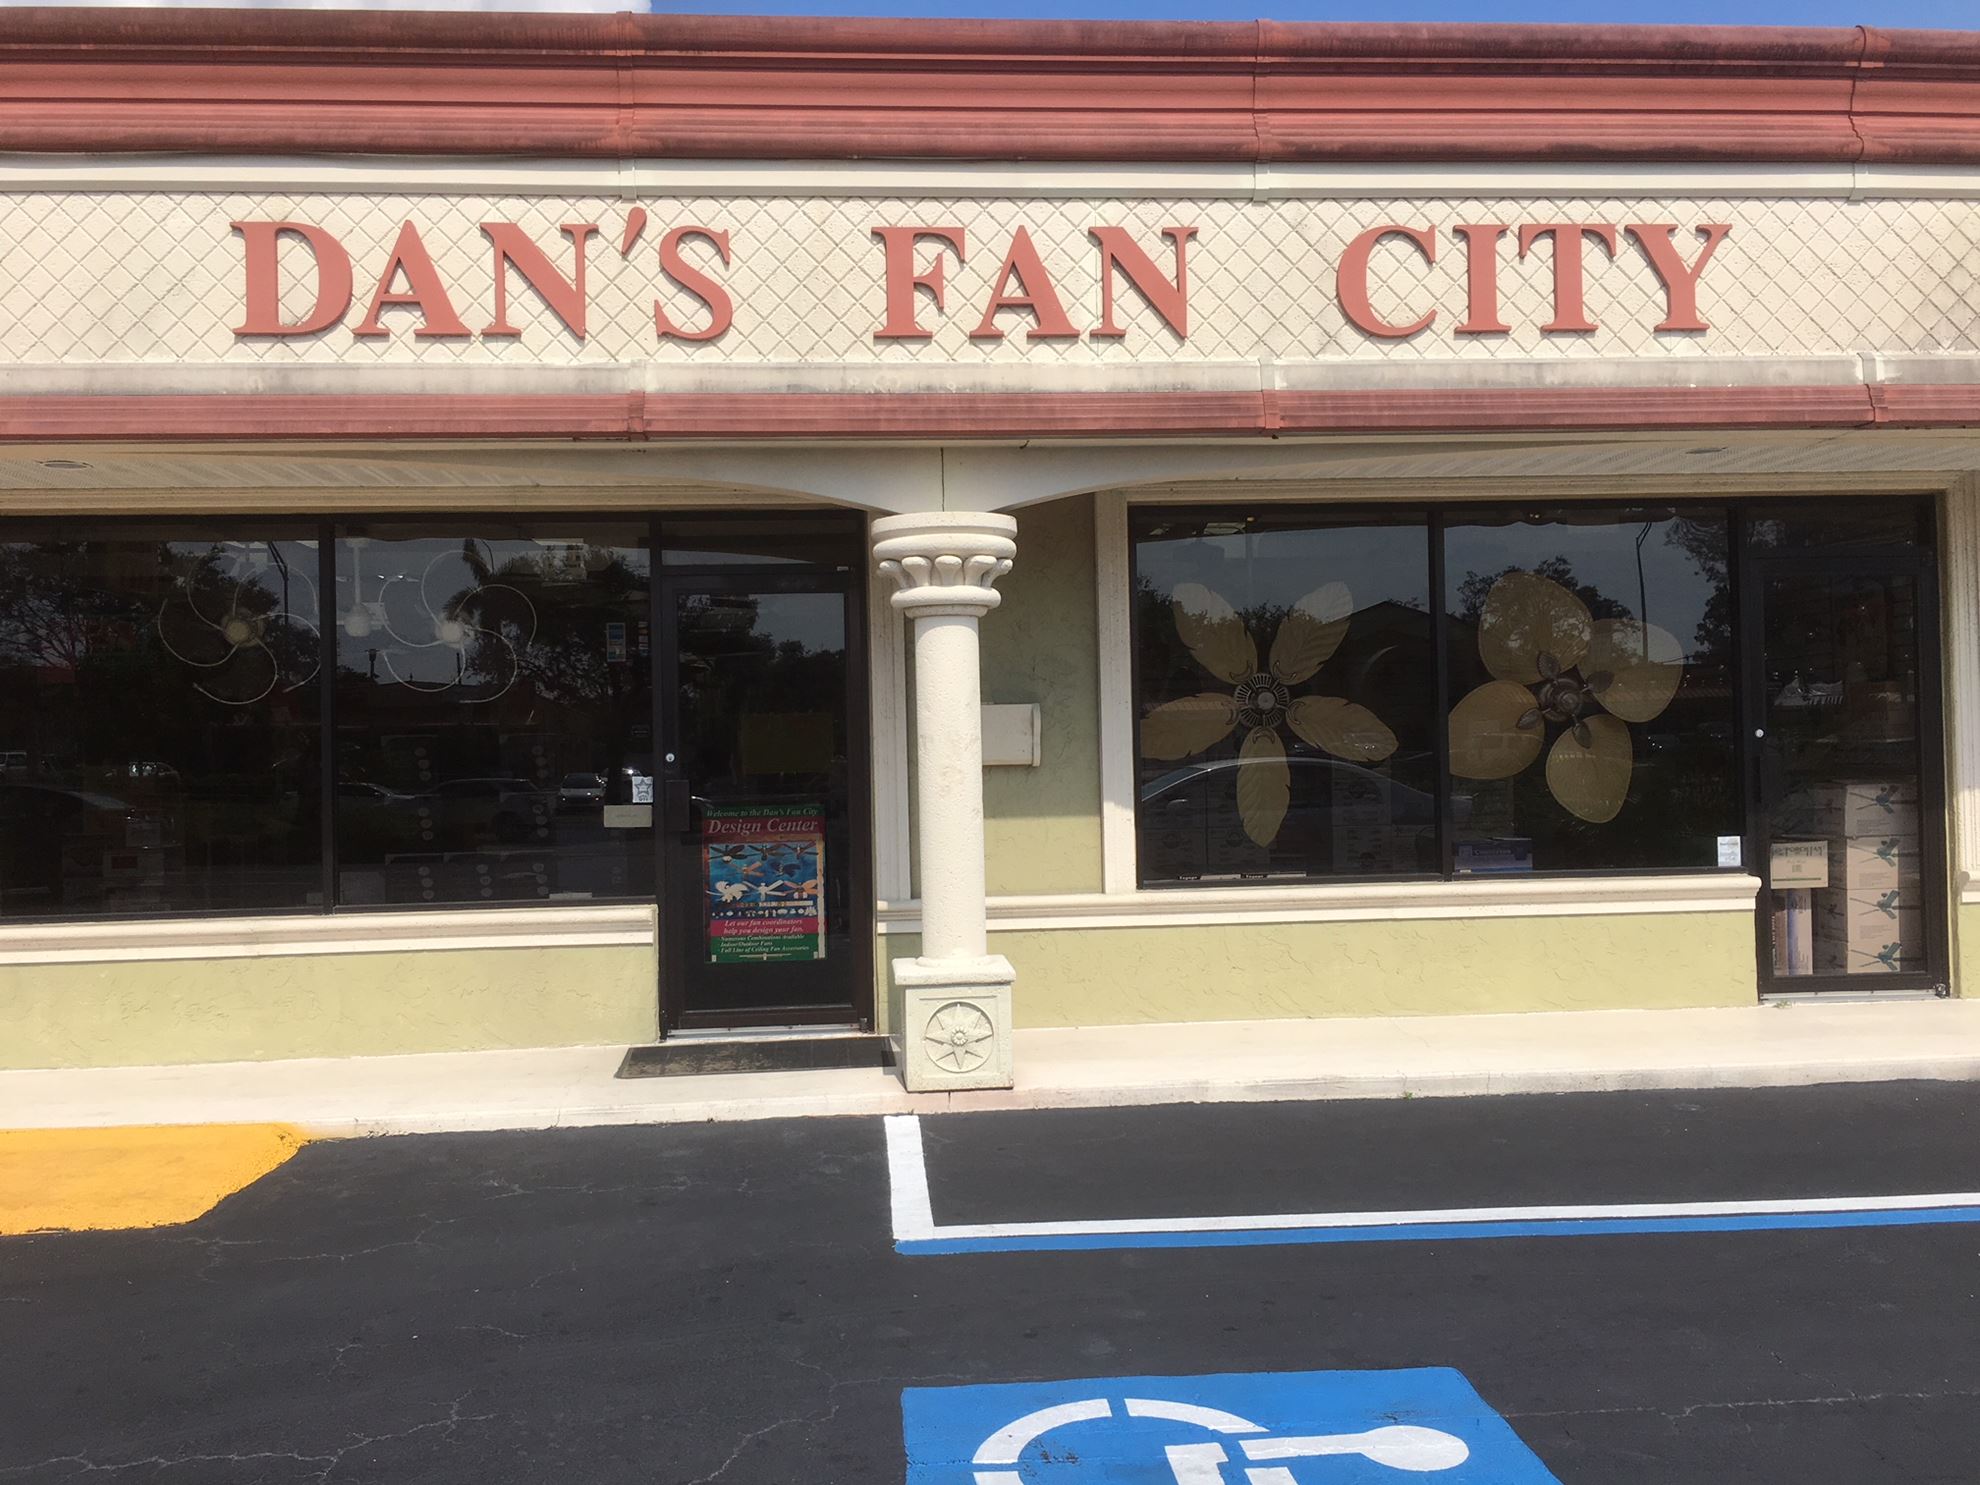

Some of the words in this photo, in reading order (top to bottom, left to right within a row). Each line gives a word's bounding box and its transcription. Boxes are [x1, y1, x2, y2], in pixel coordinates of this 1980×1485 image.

[230, 206, 734, 342] DAN'S
[871, 224, 1199, 341] FAN
[1336, 223, 1733, 340] CITY
[802, 808, 818, 816] City
[708, 819, 762, 836] Design
[767, 818, 818, 832] Center
[748, 920, 761, 928] fan
[723, 927, 737, 935] help
[753, 926, 772, 934] design
